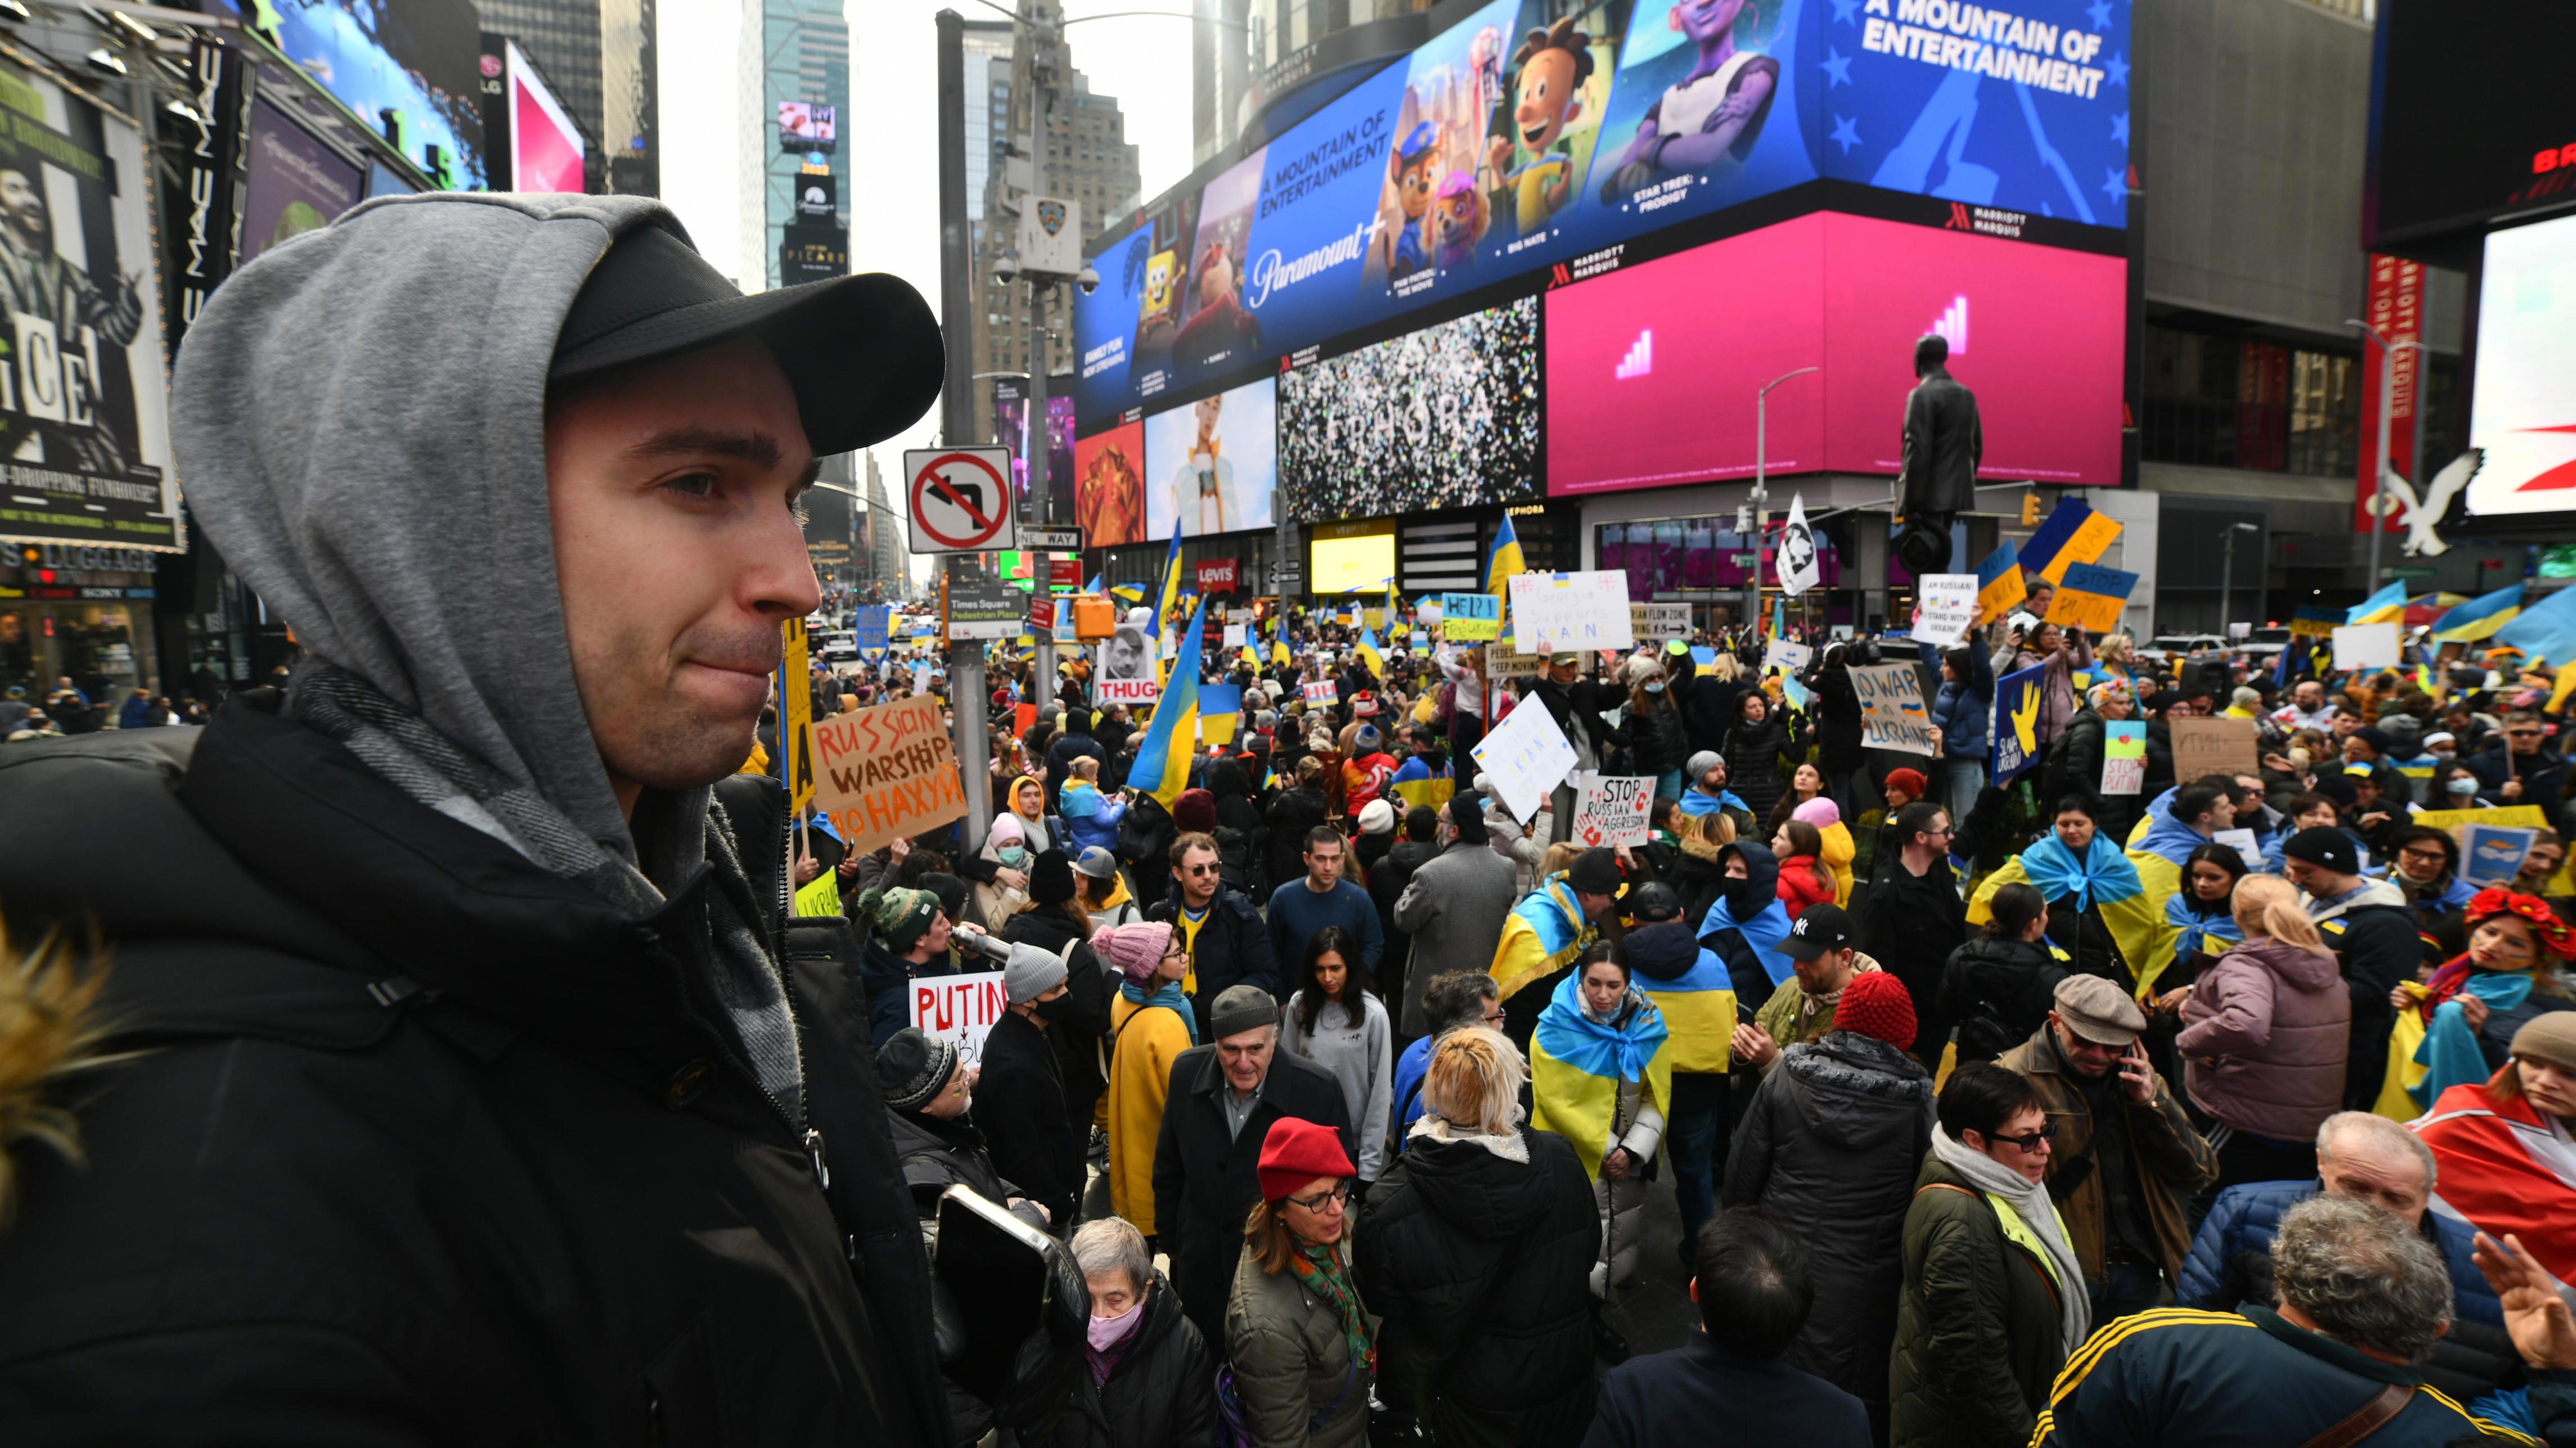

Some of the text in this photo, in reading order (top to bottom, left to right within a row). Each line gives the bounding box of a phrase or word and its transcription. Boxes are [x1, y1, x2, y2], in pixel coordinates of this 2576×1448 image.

[1896, 0, 2057, 55] MOUNTAIN
[2061, 30, 2103, 65] OF
[1862, 17, 2104, 100] ENTERTAINMENT
[480, 79, 502, 94] LG
[1262, 110, 1386, 196] A MOUNTAIN OF
[1260, 133, 1389, 220] ENTERTAINMENT
[1633, 184, 1661, 203] STAR
[1639, 188, 1687, 214] PRODIGY
[1974, 207, 2026, 224] MARRIOTT
[1974, 220, 2021, 237] MARQUIS
[1507, 232, 1547, 254] BIG NATE
[1249, 210, 1386, 308] Paramount+
[1574, 244, 1625, 268] MARRIOTT
[1574, 258, 1619, 279] MARQUIS
[1397, 278, 1434, 298] THE MOVIE
[2397, 259, 2418, 331] RRIOTT
[1509, 504, 1545, 516] EPHORA
[1047, 534, 1072, 544] WAY
[2073, 570, 2123, 588] STOP
[951, 599, 1011, 611] Times Square
[951, 610, 1019, 619] Pedestrian Plaza
[1648, 608, 1667, 620] FLOW
[1669, 608, 1687, 620] ZONE
[1522, 622, 1612, 643] UKRAINE
[1099, 680, 1157, 700] THUG
[1873, 669, 1923, 698] WAR
[2103, 774, 2137, 792] PUTIN
[1603, 780, 1640, 808] STOP
[1587, 801, 1630, 817] RUSSIAN
[1602, 815, 1645, 831] AGGRESSION
[918, 979, 1008, 1033] PUTIN
